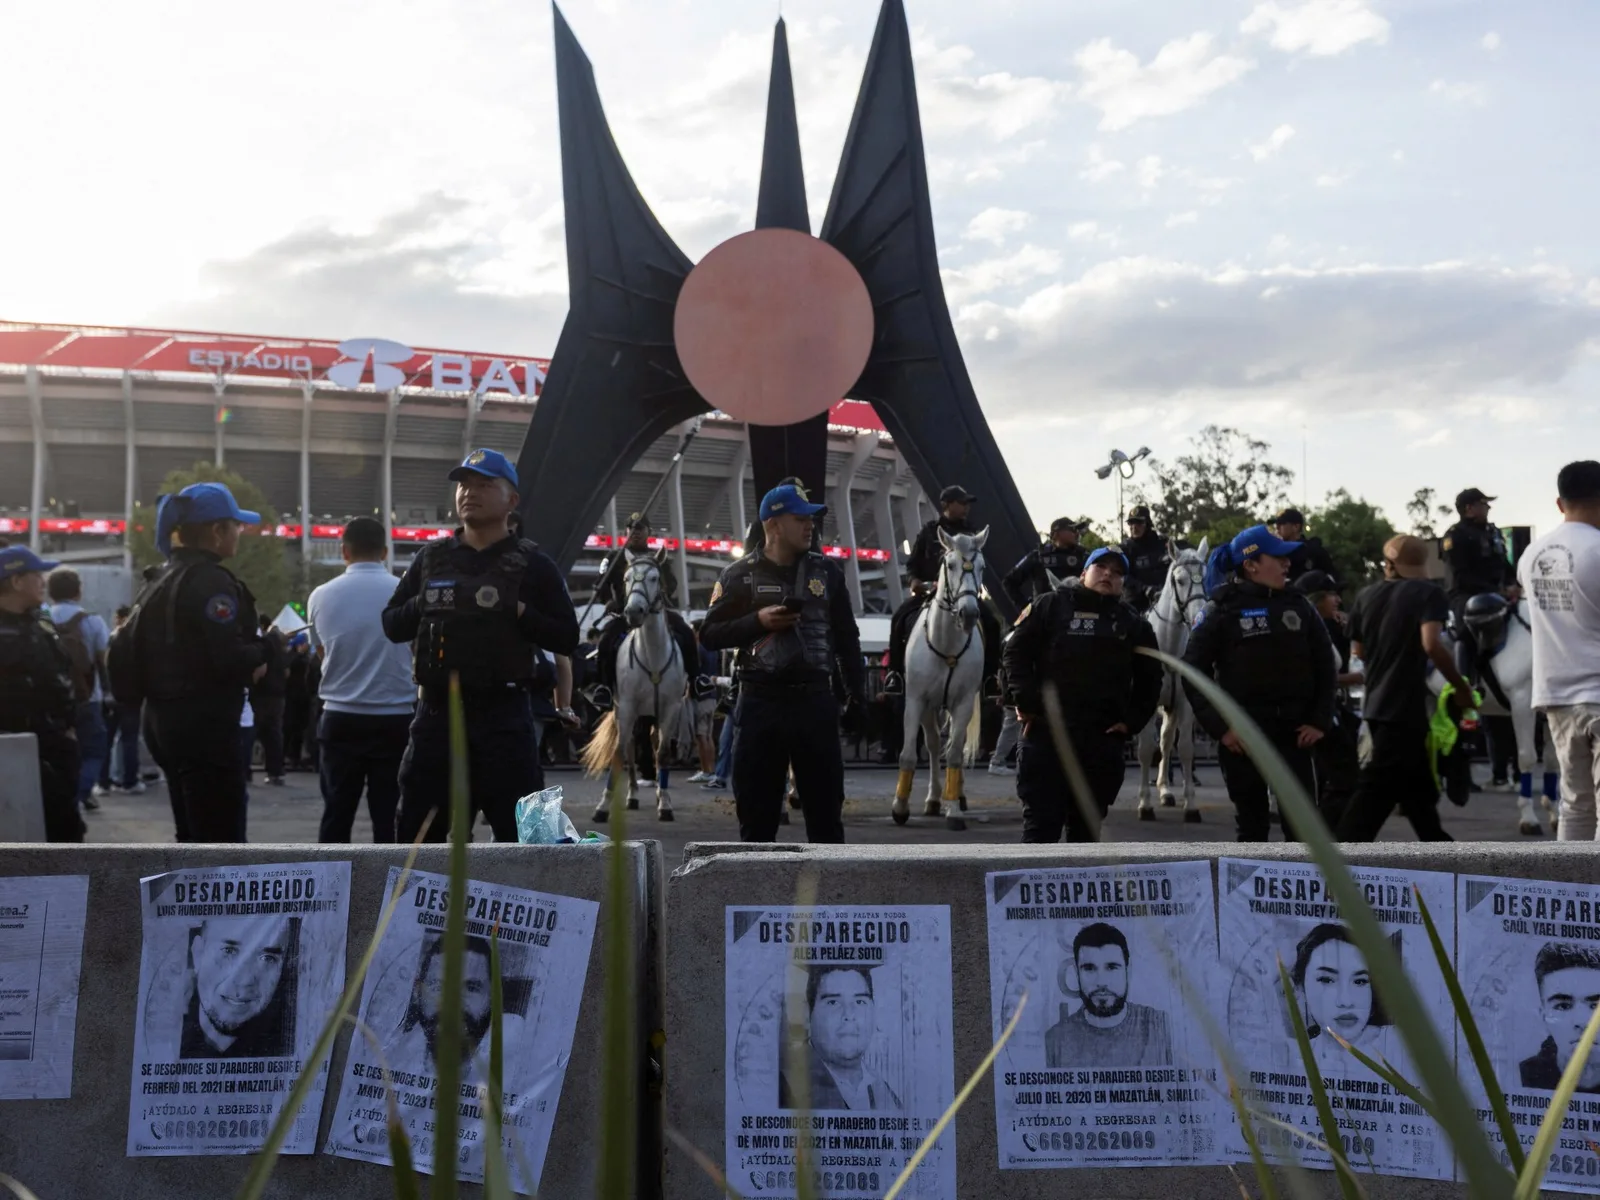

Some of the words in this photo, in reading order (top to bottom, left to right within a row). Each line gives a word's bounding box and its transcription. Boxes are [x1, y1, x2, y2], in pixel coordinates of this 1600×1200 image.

[189, 348, 311, 373] ESTADIO
[202, 872, 226, 881] FALTAS
[263, 870, 287, 878] FALTAN
[1029, 873, 1043, 881] NOS
[1048, 872, 1073, 880] FALTAS
[1114, 870, 1140, 879] FALTAN
[1145, 869, 1167, 877] TODOS
[1264, 867, 1278, 875] NOS
[1283, 868, 1310, 878] FALTAS
[1384, 875, 1408, 884] TODOS
[174, 878, 315, 904] DESAPARECIDO
[1020, 878, 1173, 904] DESAPARECIDO
[1504, 884, 1518, 893] NOS
[1524, 886, 1552, 896] FALTAS
[1576, 890, 1589, 899] NOS
[157, 904, 177, 917] LUIS
[178, 902, 223, 916] HUMBERTO
[226, 901, 281, 915] VALDELAMAR
[282, 899, 337, 913] BUSTAMANTE
[414, 886, 558, 932] DESPARECIDO
[768, 911, 782, 919] NOS
[817, 909, 829, 920] TÚ,
[835, 911, 848, 919] NOS
[853, 911, 879, 919] FALTAN
[883, 911, 906, 919] TODOS
[1006, 907, 1046, 920] MISRAEL
[1049, 905, 1094, 919] ARMANDO
[1097, 902, 1148, 918] SEPÚLVEDA
[1249, 899, 1291, 916] YAJAIRA
[1294, 901, 1326, 918] SUJEY
[1373, 907, 1423, 925] ERNÁNDEZ
[417, 910, 444, 928] CÉSAR
[486, 924, 526, 943] BRTOLDI
[528, 929, 551, 947] PÁEZ
[759, 921, 910, 943] DESAPARECIDO
[1503, 917, 1529, 934] SAÚL
[1532, 922, 1557, 937] YAEL
[1561, 924, 1600, 940] BUSTOS
[792, 946, 817, 961] ALEX
[820, 944, 856, 961] PELÁEZ
[858, 946, 882, 961] SOTO
[141, 1063, 152, 1076] SE
[154, 1062, 203, 1076] DESCONOCE
[206, 1062, 218, 1075] SU
[219, 1060, 264, 1075] PARADERO
[267, 1060, 293, 1074] DESDE
[353, 1062, 364, 1077] SE
[366, 1064, 416, 1088] DESONOCE
[418, 1075, 430, 1090] SU
[1005, 1072, 1017, 1085] SE
[1019, 1071, 1074, 1085] DESCONOCE
[1077, 1071, 1090, 1084] SU
[1092, 1070, 1142, 1084] PARADERO
[1145, 1069, 1175, 1083] DESDE
[1178, 1069, 1189, 1082] EL
[143, 1081, 179, 1095] FEBRERO
[182, 1081, 198, 1094] DEL
[201, 1080, 222, 1093] 2021
[224, 1080, 236, 1093] EN
[237, 1077, 286, 1094] MAZATLÁN,
[1250, 1071, 1267, 1085] FUE
[1269, 1072, 1306, 1087] PRIVADA
[1338, 1078, 1378, 1094] LIBERTAD
[1381, 1082, 1391, 1096] EL
[357, 1083, 384, 1101] MAYO
[403, 1092, 427, 1109] 2023
[1015, 1091, 1042, 1105] JULIO
[1045, 1091, 1062, 1104] DEL
[1065, 1091, 1091, 1104] 2020
[1094, 1090, 1107, 1103] EN
[1109, 1086, 1164, 1104] MAZATLÁN,
[1288, 1092, 1304, 1106] DEL
[1332, 1096, 1343, 1110] EN
[1346, 1097, 1397, 1115] MAZATLÁN,
[143, 1103, 197, 1120] ¡AYÚDALO
[203, 1105, 210, 1115] A
[217, 1104, 273, 1116] REGRESAR
[1568, 1099, 1580, 1113] SU
[409, 1118, 416, 1129] A
[423, 1120, 477, 1141] RESAR
[741, 1116, 753, 1130] SE
[812, 1116, 825, 1130] SU
[827, 1116, 876, 1131] PARADERO
[879, 1117, 909, 1131] DESDE
[1012, 1113, 1071, 1132] ¡AYÚDALO
[1080, 1115, 1087, 1125] A
[1095, 1114, 1157, 1126] REGRESAR
[1164, 1114, 1172, 1125] A
[1300, 1115, 1308, 1126] A
[1385, 1122, 1393, 1133] A
[1578, 1119, 1589, 1132] EN
[737, 1135, 749, 1149] DE
[752, 1135, 780, 1149] MAYO
[828, 1136, 840, 1149] EN
[843, 1133, 897, 1151] MAZATLÁN,
[1039, 1130, 1156, 1150] 6693262089
[821, 1155, 881, 1167] REGRESAR
[889, 1157, 897, 1167] A
[766, 1171, 880, 1191] 669262089
